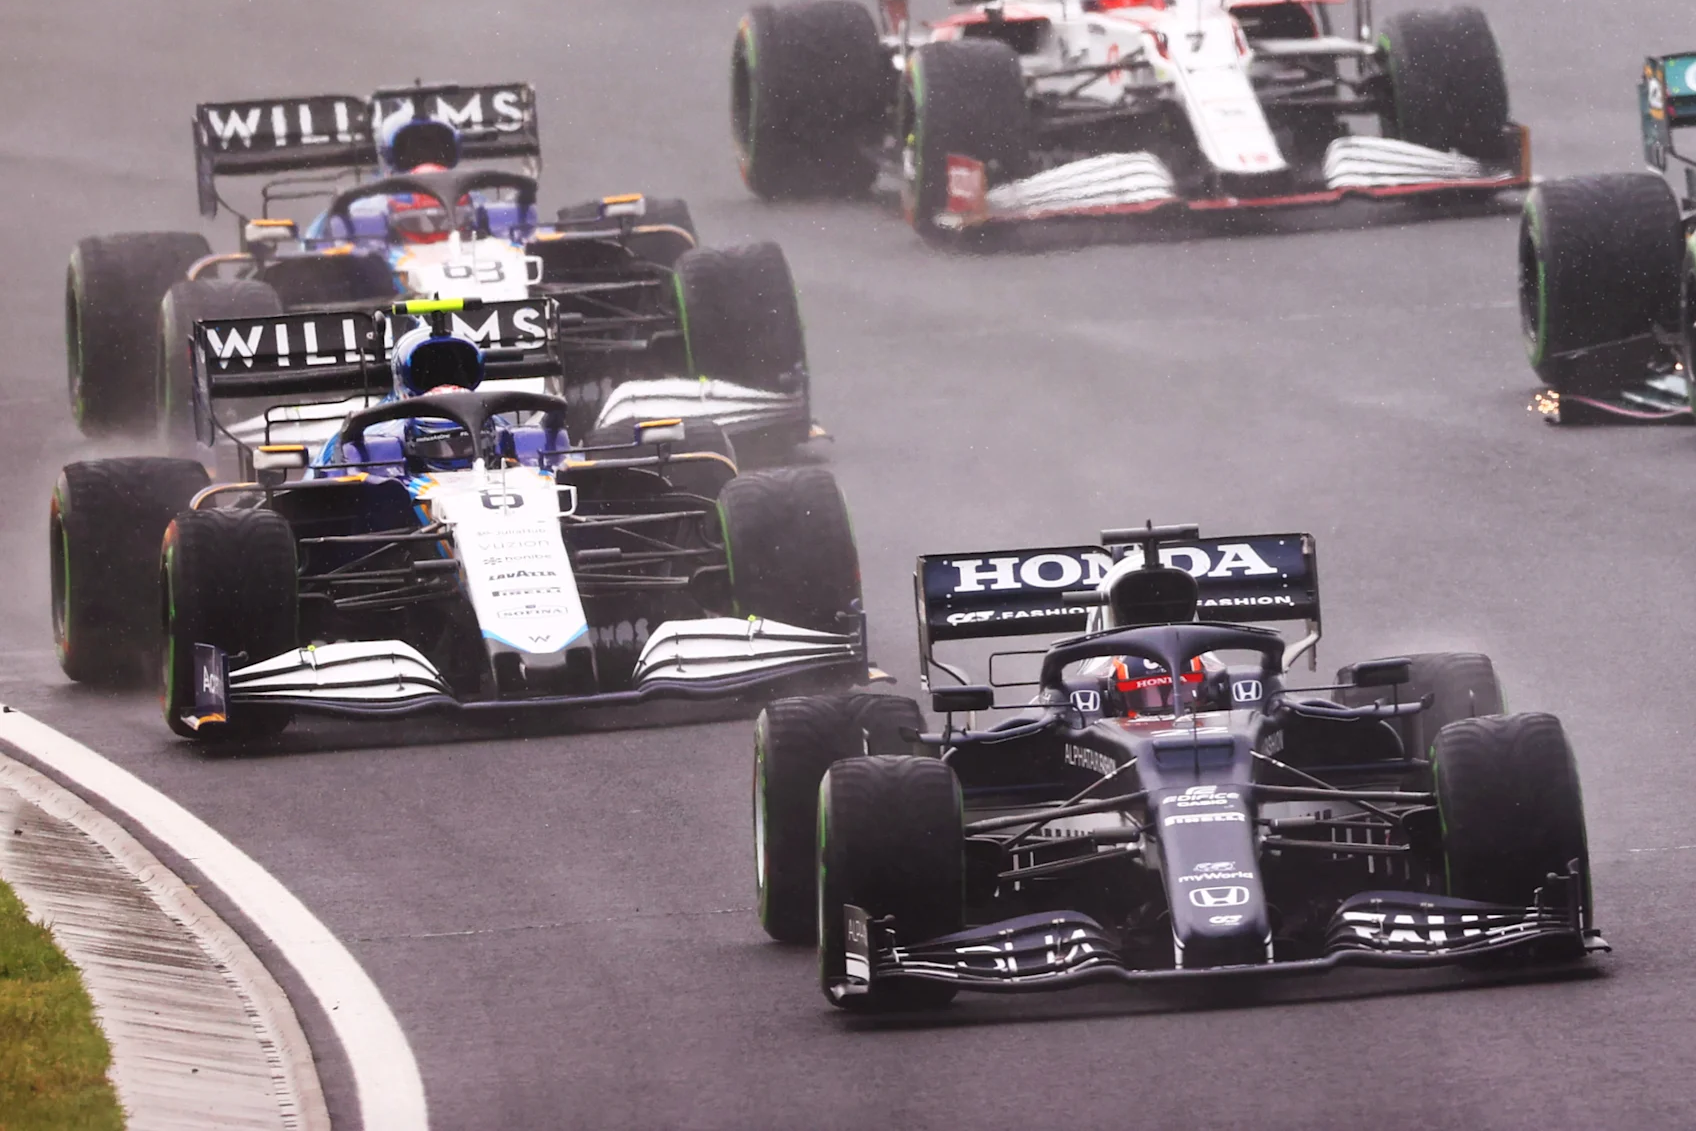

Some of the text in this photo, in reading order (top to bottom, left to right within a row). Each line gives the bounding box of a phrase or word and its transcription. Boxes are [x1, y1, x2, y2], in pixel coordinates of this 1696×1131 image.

[478, 489, 525, 510] 6
[488, 570, 557, 582] LAVAZZA
[1164, 812, 1246, 827] PIRELLI
[1178, 871, 1254, 883] myWorld
